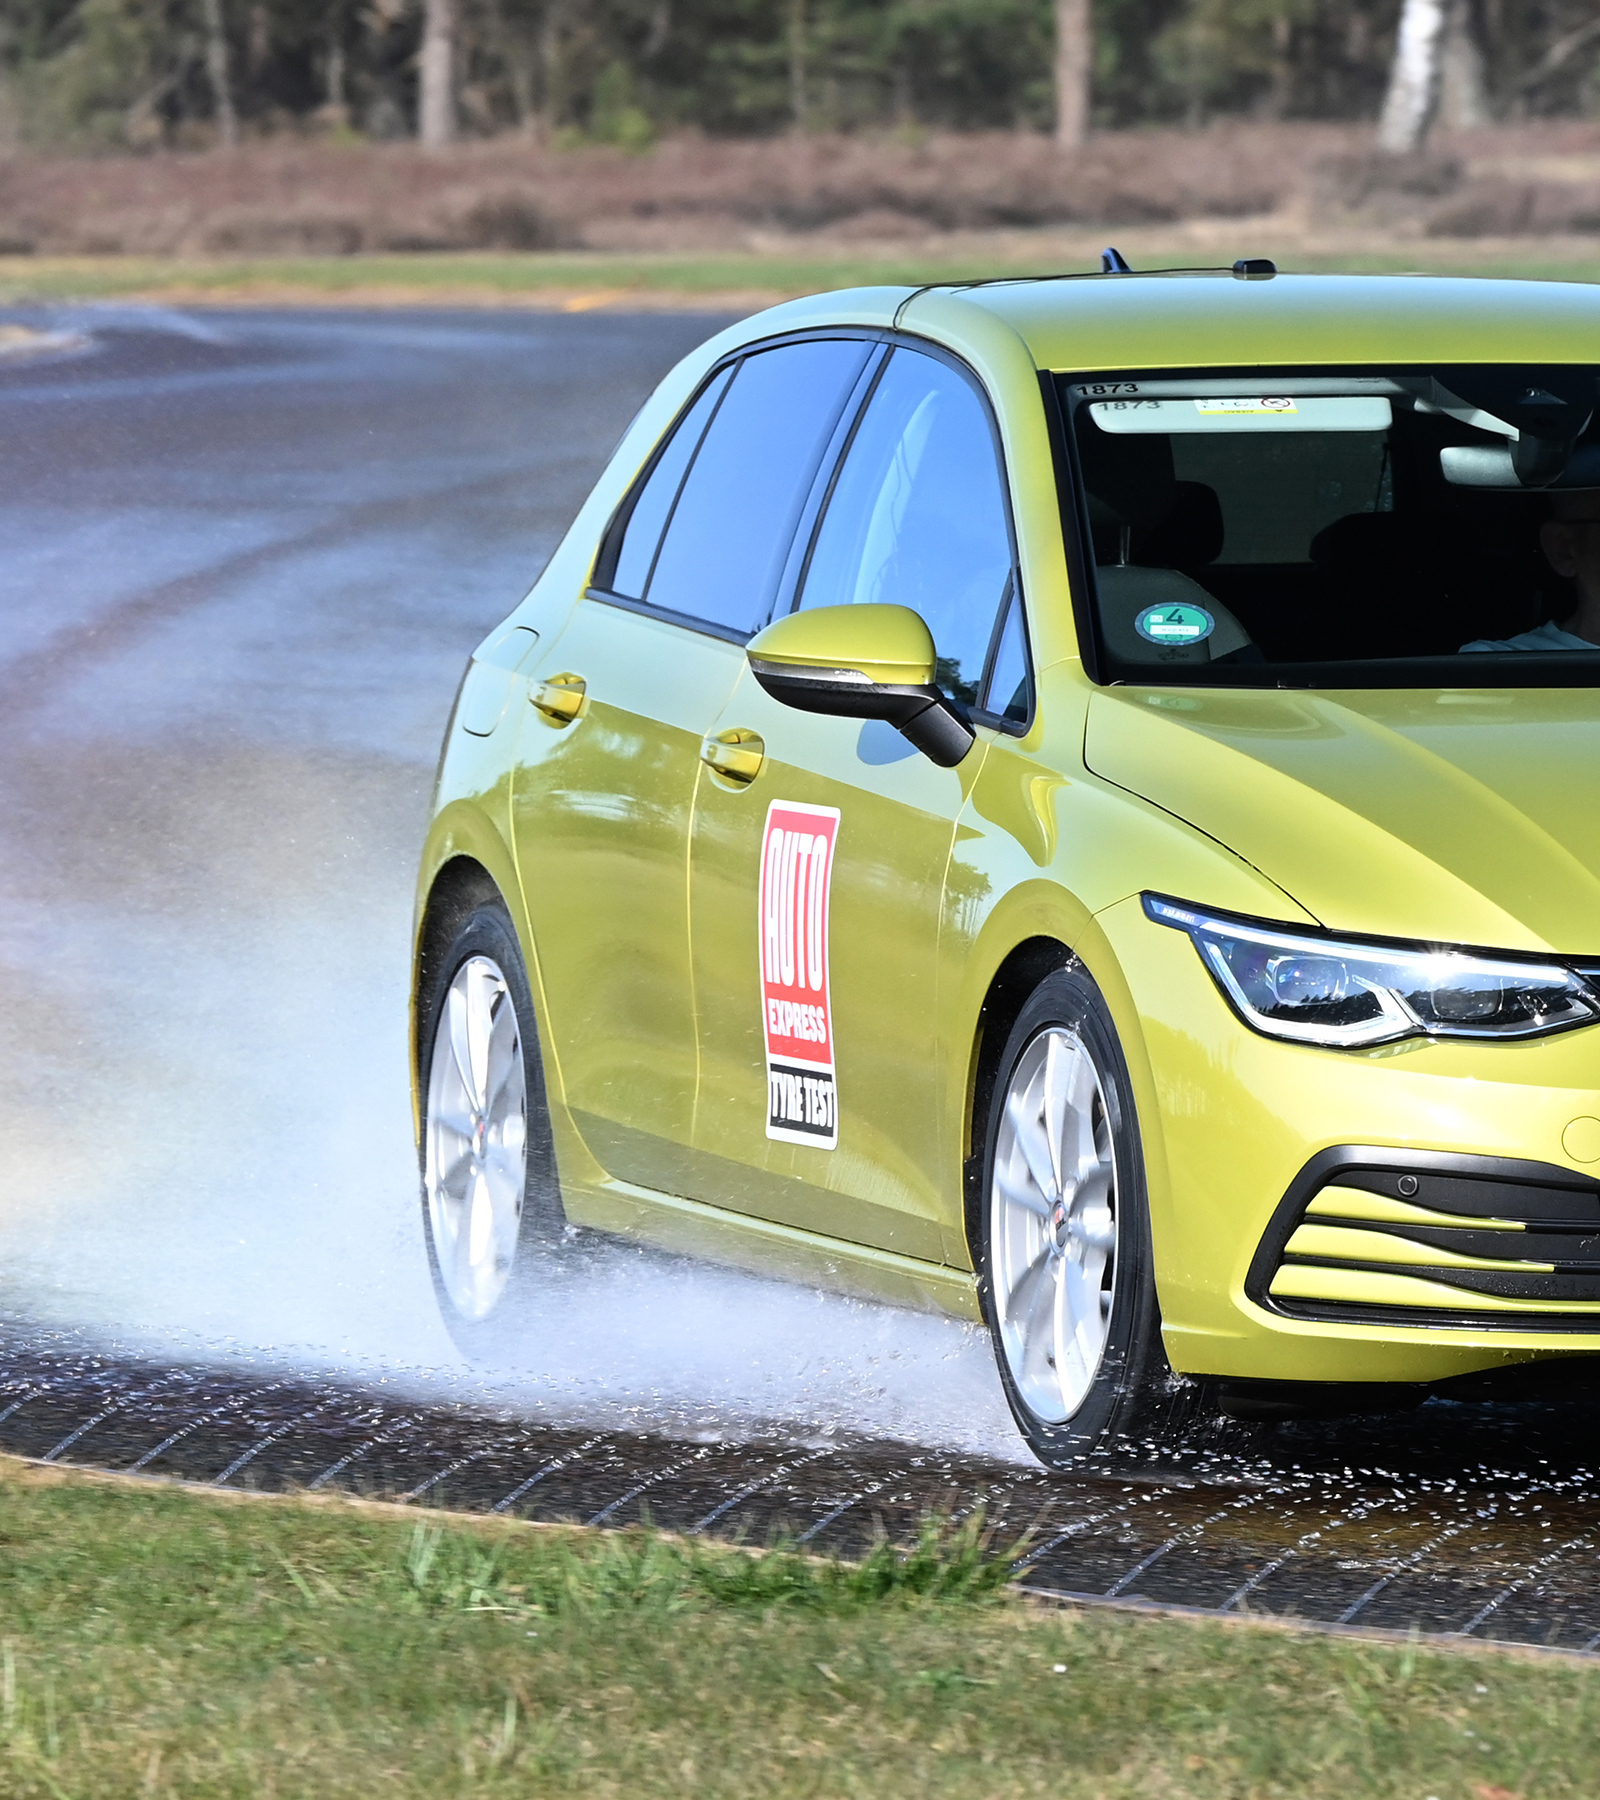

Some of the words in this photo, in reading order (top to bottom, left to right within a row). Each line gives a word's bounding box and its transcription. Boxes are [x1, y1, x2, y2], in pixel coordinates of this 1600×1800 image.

[1077, 383, 1139, 396] 1873
[1166, 608, 1185, 625] 4
[764, 827, 828, 992] AUTO
[768, 997, 827, 1044] EXPRESS
[770, 1071, 804, 1123] TYRE
[803, 1077, 834, 1128] TEST
